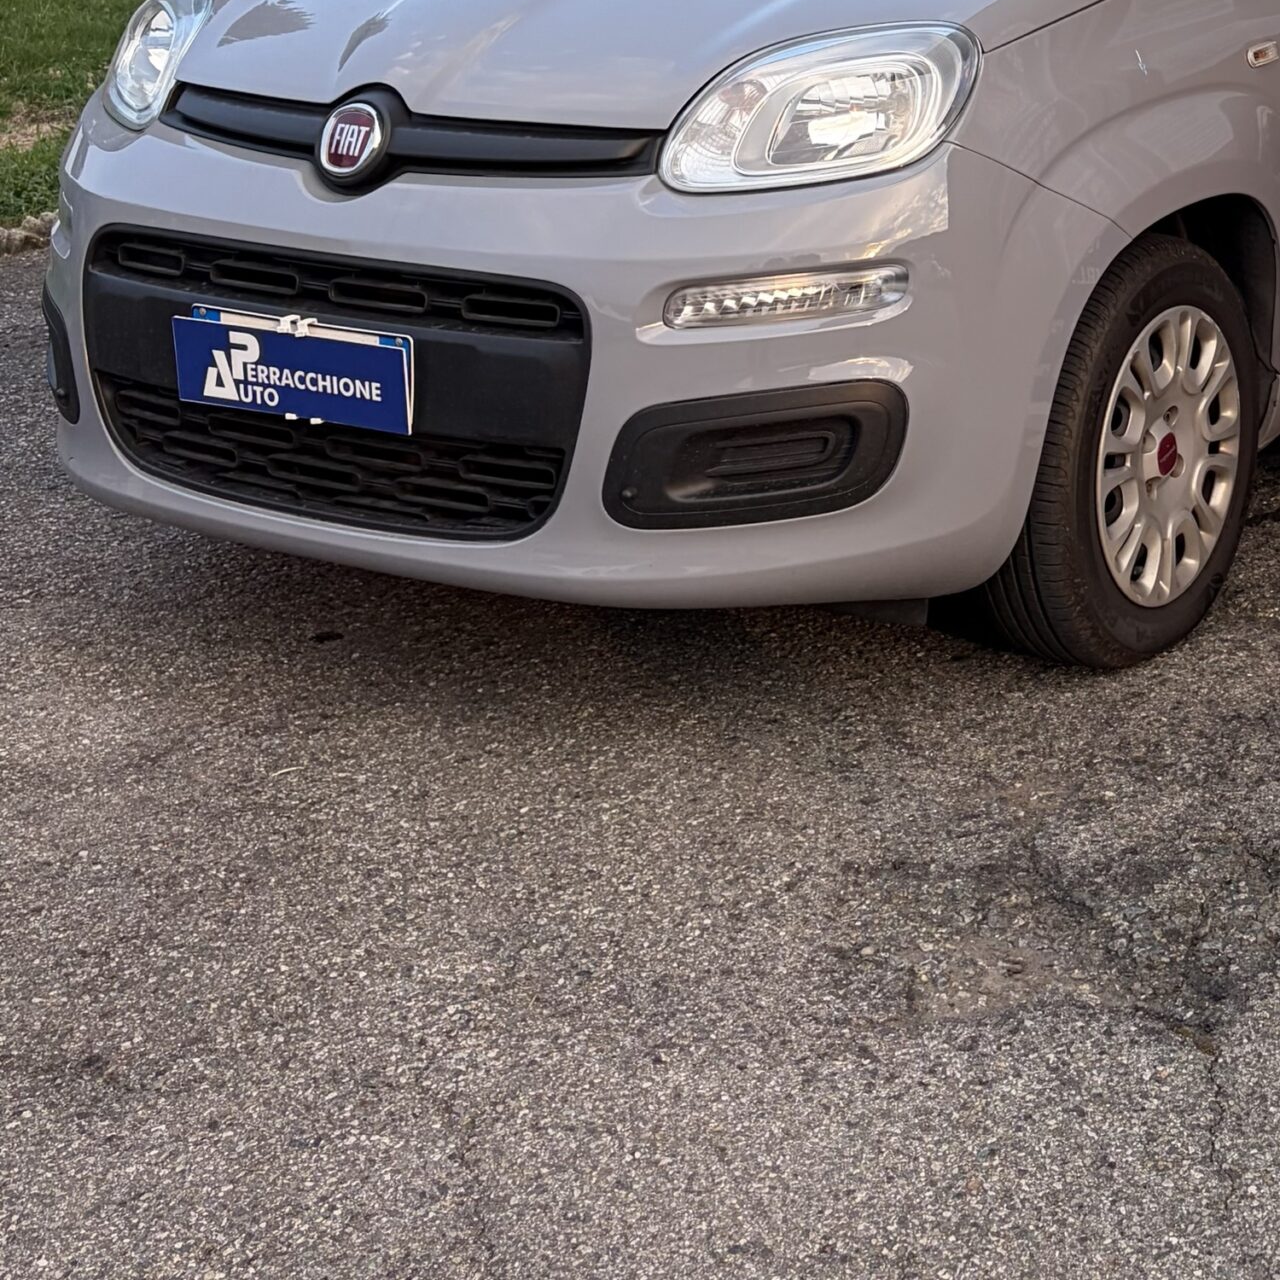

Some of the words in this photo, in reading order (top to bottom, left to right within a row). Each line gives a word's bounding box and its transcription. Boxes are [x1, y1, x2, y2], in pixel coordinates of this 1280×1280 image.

[330, 122, 371, 158] FIAT
[202, 349, 280, 407] AUTO
[228, 330, 382, 403] PERRACCHIONE
